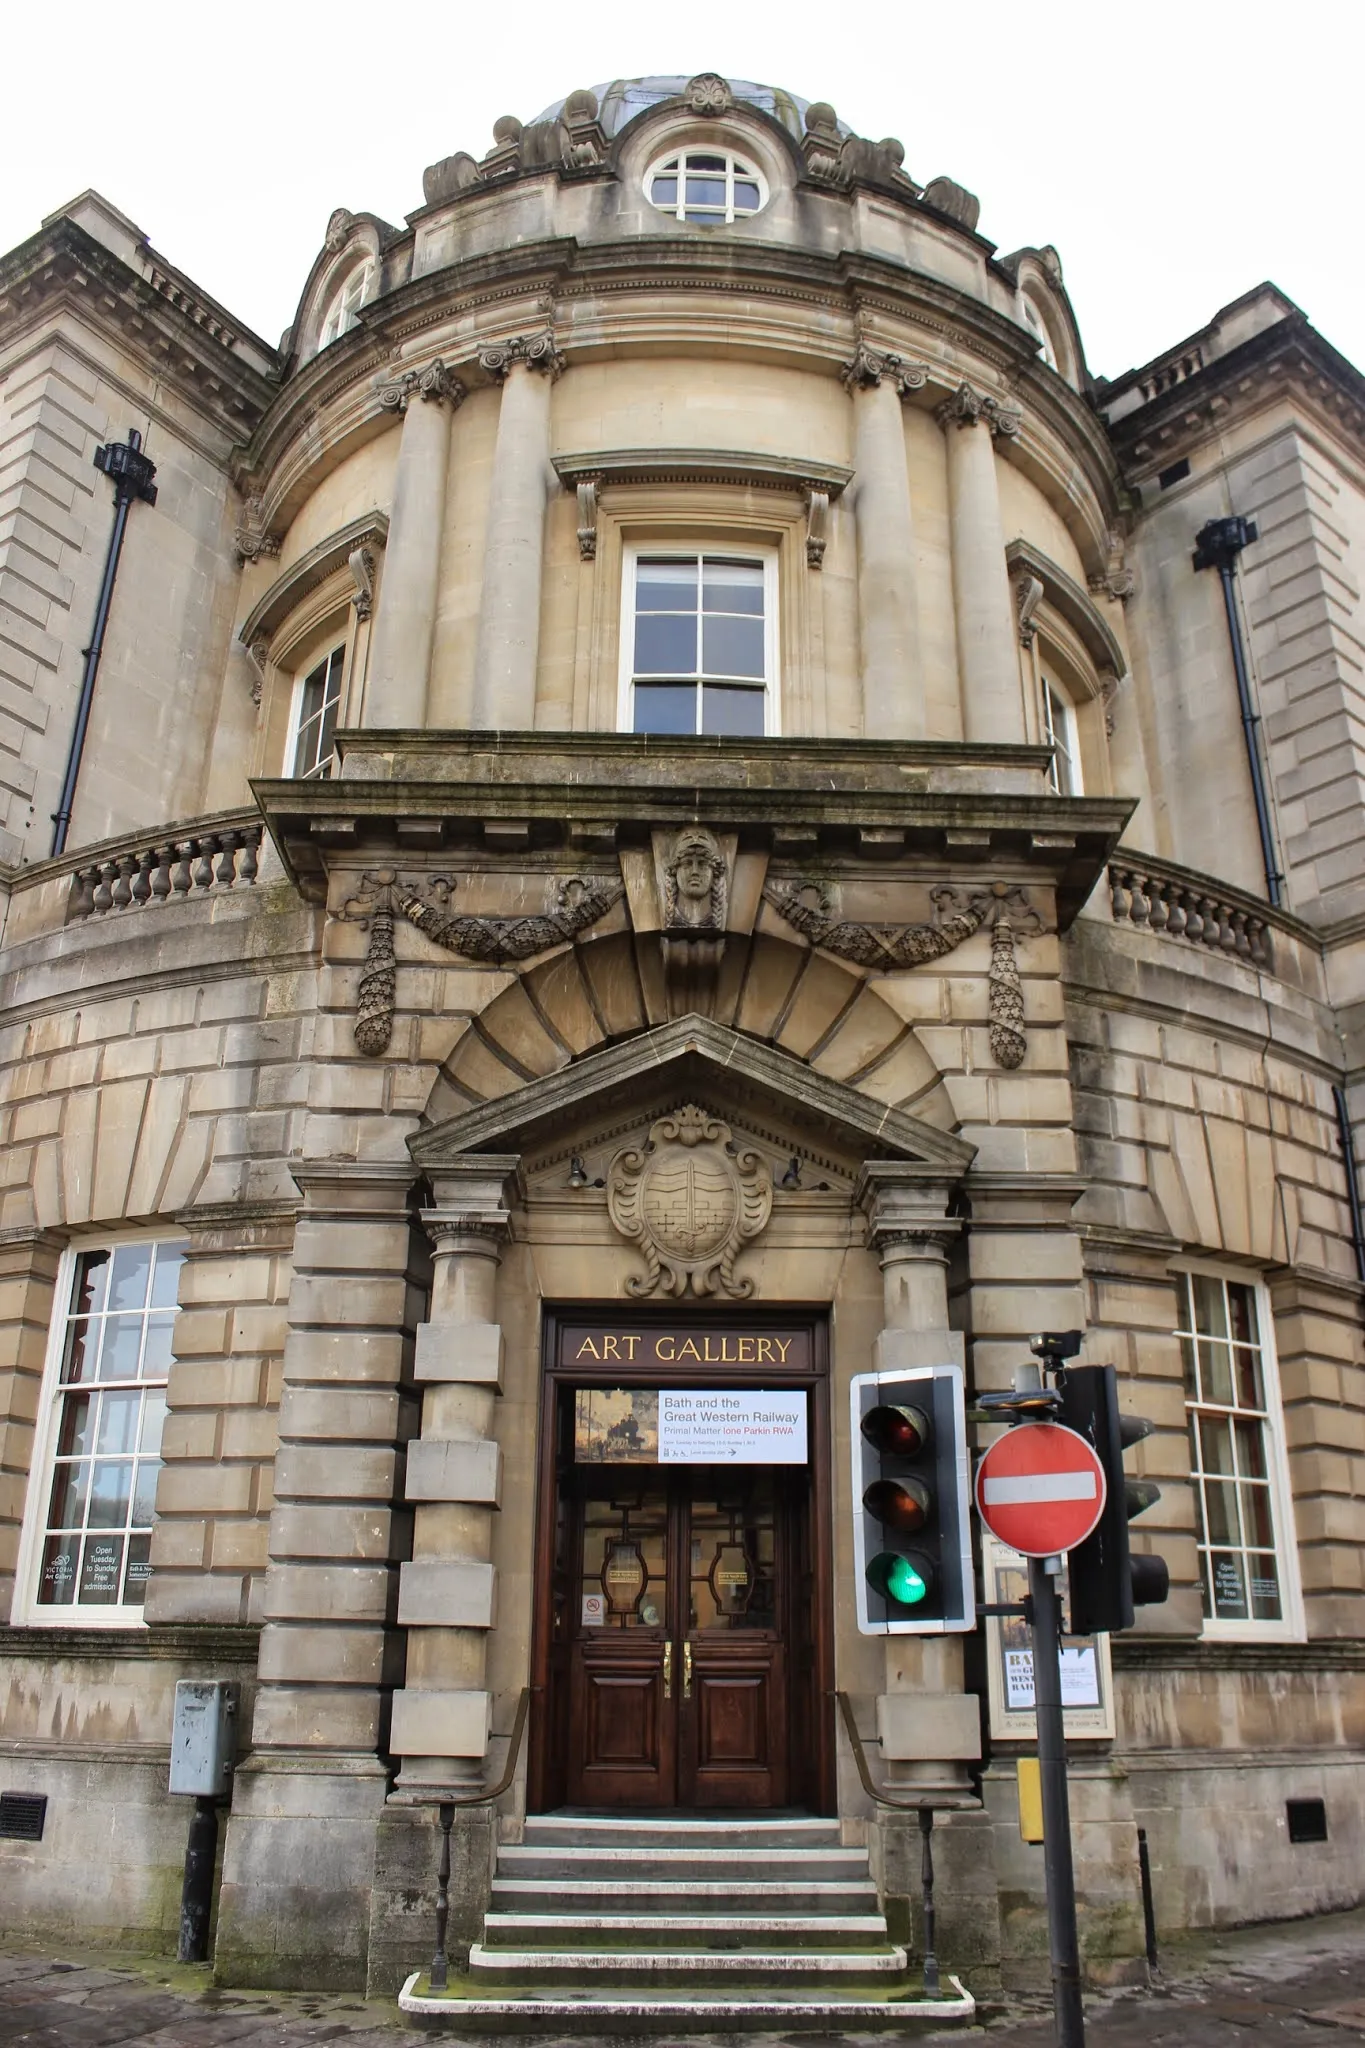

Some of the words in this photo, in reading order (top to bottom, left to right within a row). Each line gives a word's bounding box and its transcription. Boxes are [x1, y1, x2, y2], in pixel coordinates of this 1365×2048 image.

[575, 1336, 642, 1360] ART
[655, 1337, 793, 1363] GALLERY
[664, 1397, 692, 1408] Bath
[695, 1397, 718, 1408] and
[721, 1397, 740, 1408] the
[664, 1411, 696, 1422] Great
[700, 1411, 749, 1422] Western
[753, 1411, 799, 1424] Railway
[664, 1426, 691, 1435] Primal
[693, 1426, 721, 1435] Matter
[744, 1426, 770, 1435] Parkin
[772, 1426, 794, 1435] RWA
[95, 1546, 113, 1555] Open
[90, 1555, 117, 1564] Tuesday
[94, 1565, 118, 1574] Sunday
[55, 1573, 72, 1581] Gallery
[94, 1573, 108, 1581] Free
[84, 1583, 116, 1591] admission
[1224, 1589, 1237, 1597] Free
[1009, 1654, 1033, 1666] BA
